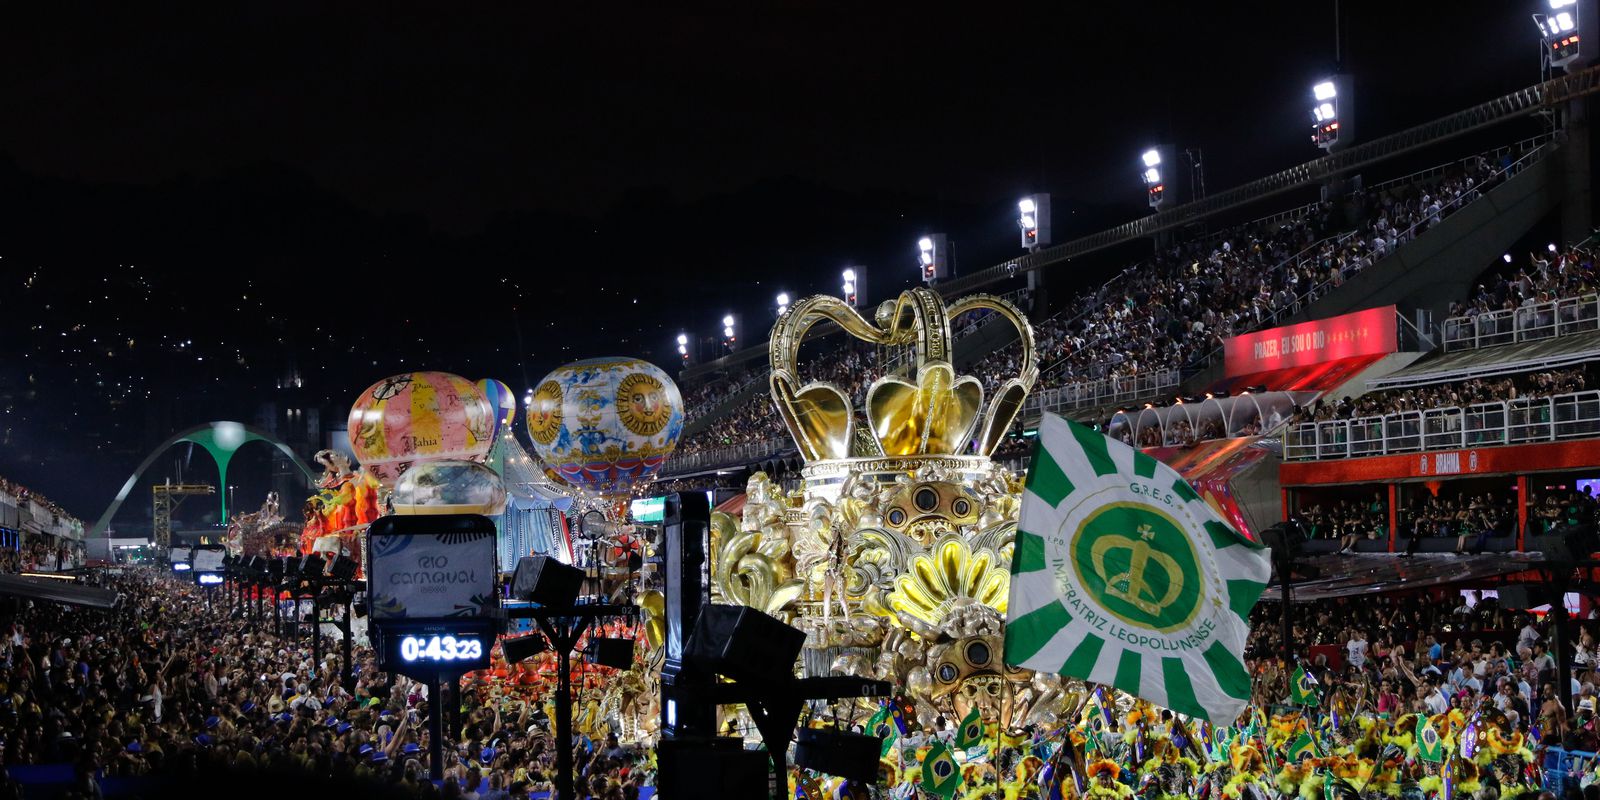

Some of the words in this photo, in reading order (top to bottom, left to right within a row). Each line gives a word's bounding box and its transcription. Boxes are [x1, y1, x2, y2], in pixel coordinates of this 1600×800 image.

[1254, 339, 1280, 360] PRAZER,
[1281, 336, 1290, 355] EU
[1291, 334, 1305, 353] SOU
[1306, 334, 1310, 351] O
[1312, 330, 1325, 350] RIO
[1435, 452, 1460, 474] BRAHMA
[1129, 482, 1174, 508] G.R.E.S.
[418, 555, 448, 569] RIO
[1051, 558, 1108, 631] IMPERATRIZ
[621, 606, 633, 615] 02
[862, 684, 877, 697] 01
